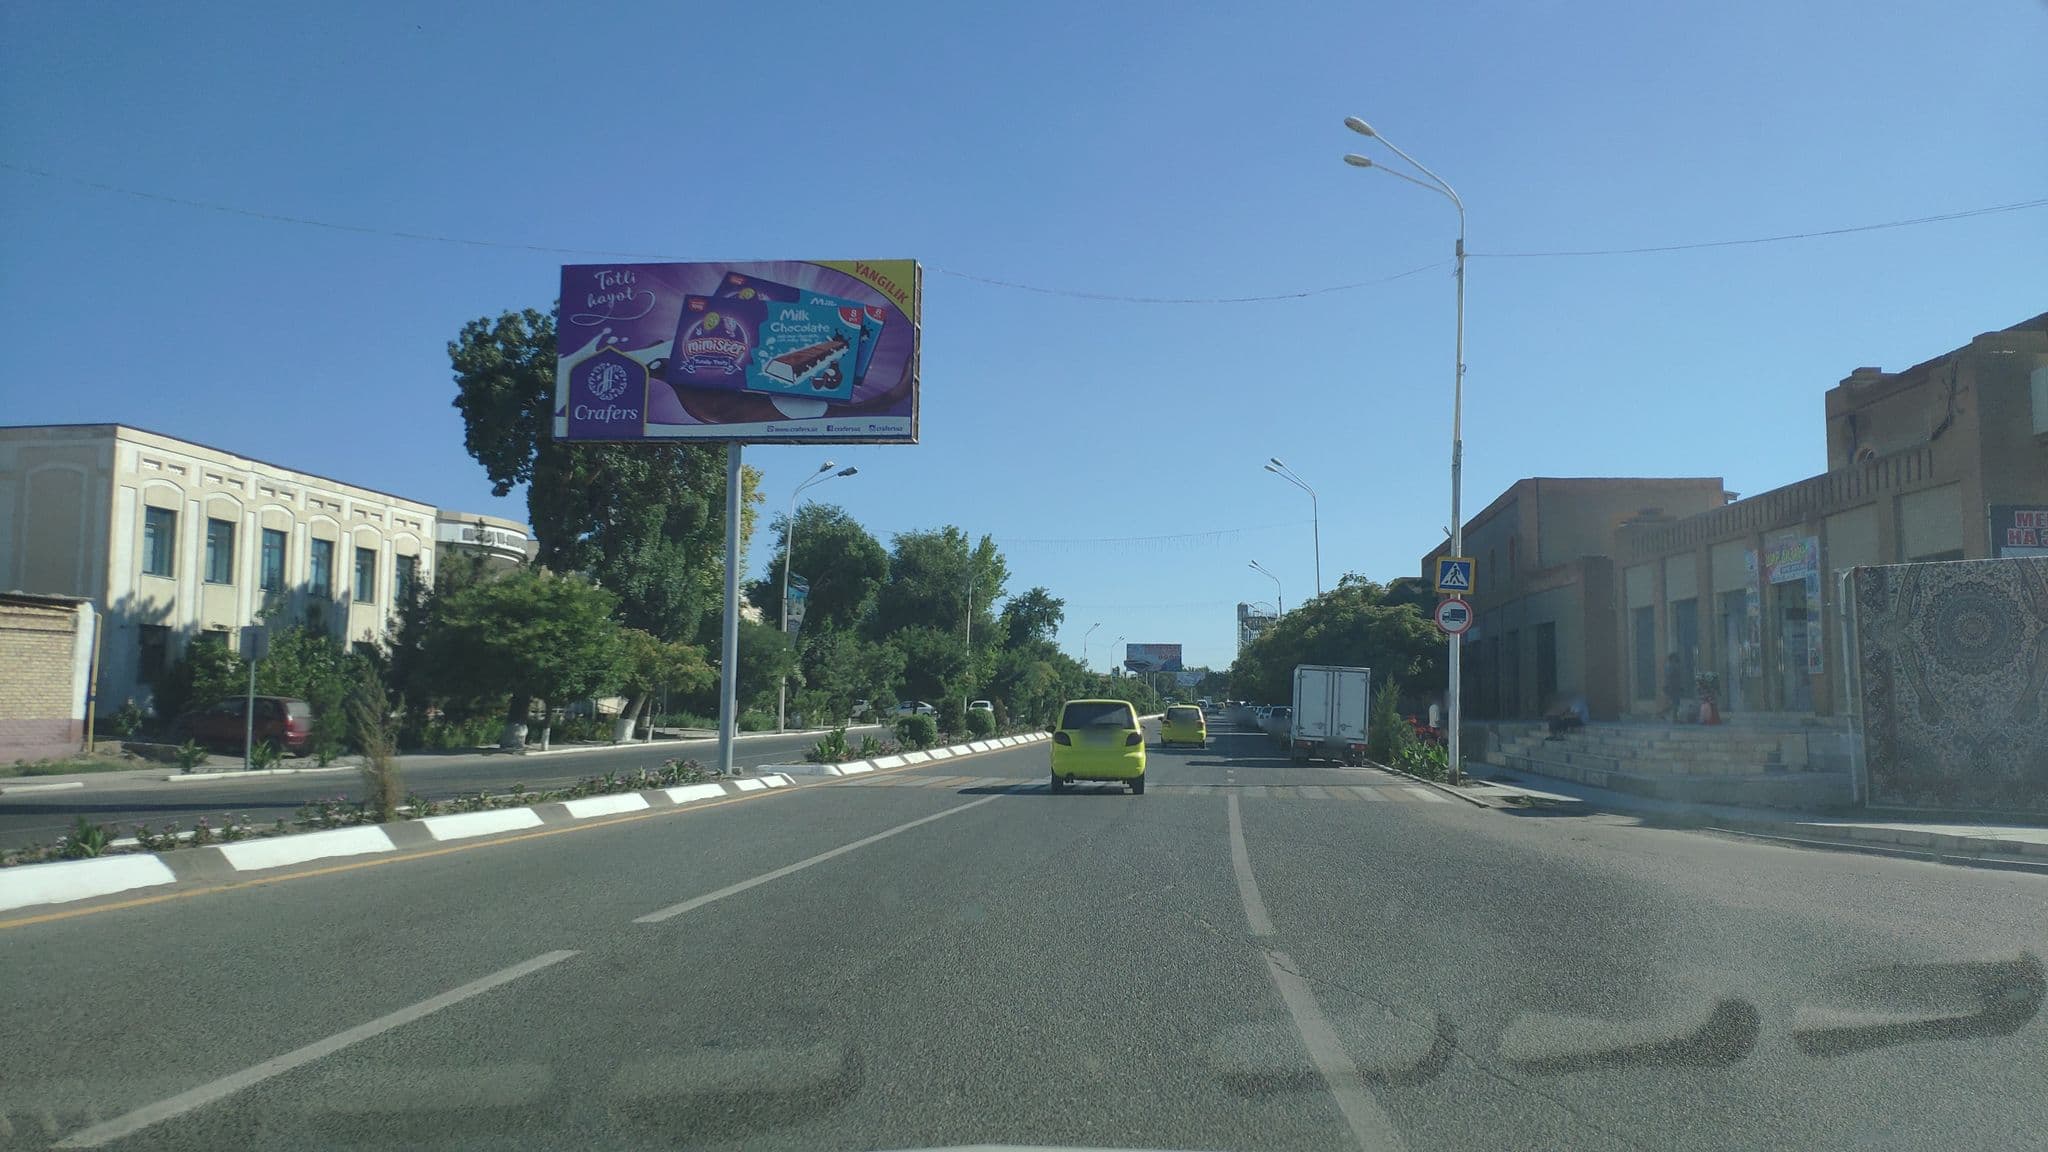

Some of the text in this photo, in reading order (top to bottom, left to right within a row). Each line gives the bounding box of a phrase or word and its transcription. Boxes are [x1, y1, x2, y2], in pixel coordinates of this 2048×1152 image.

[594, 270, 636, 290] Totli
[855, 261, 909, 304] YANGILIK
[780, 309, 810, 321] Milk
[770, 322, 830, 333] Chocolate
[575, 404, 639, 424] Crafers
